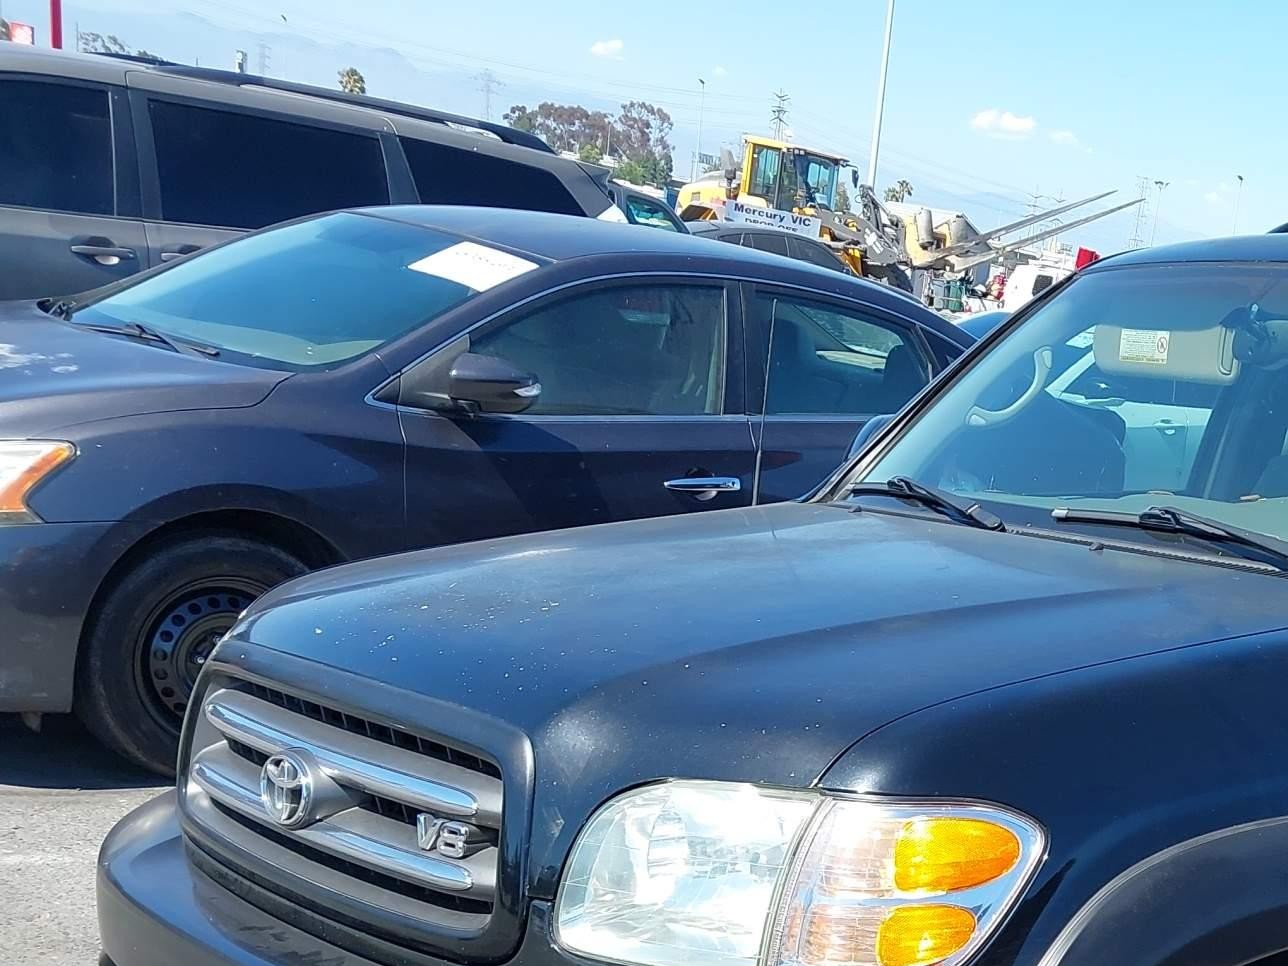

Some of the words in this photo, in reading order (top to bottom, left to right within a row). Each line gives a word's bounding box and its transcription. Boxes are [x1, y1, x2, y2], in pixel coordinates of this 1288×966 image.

[734, 203, 785, 222] Mercury
[791, 215, 811, 227] VIC
[417, 813, 469, 857] V8
